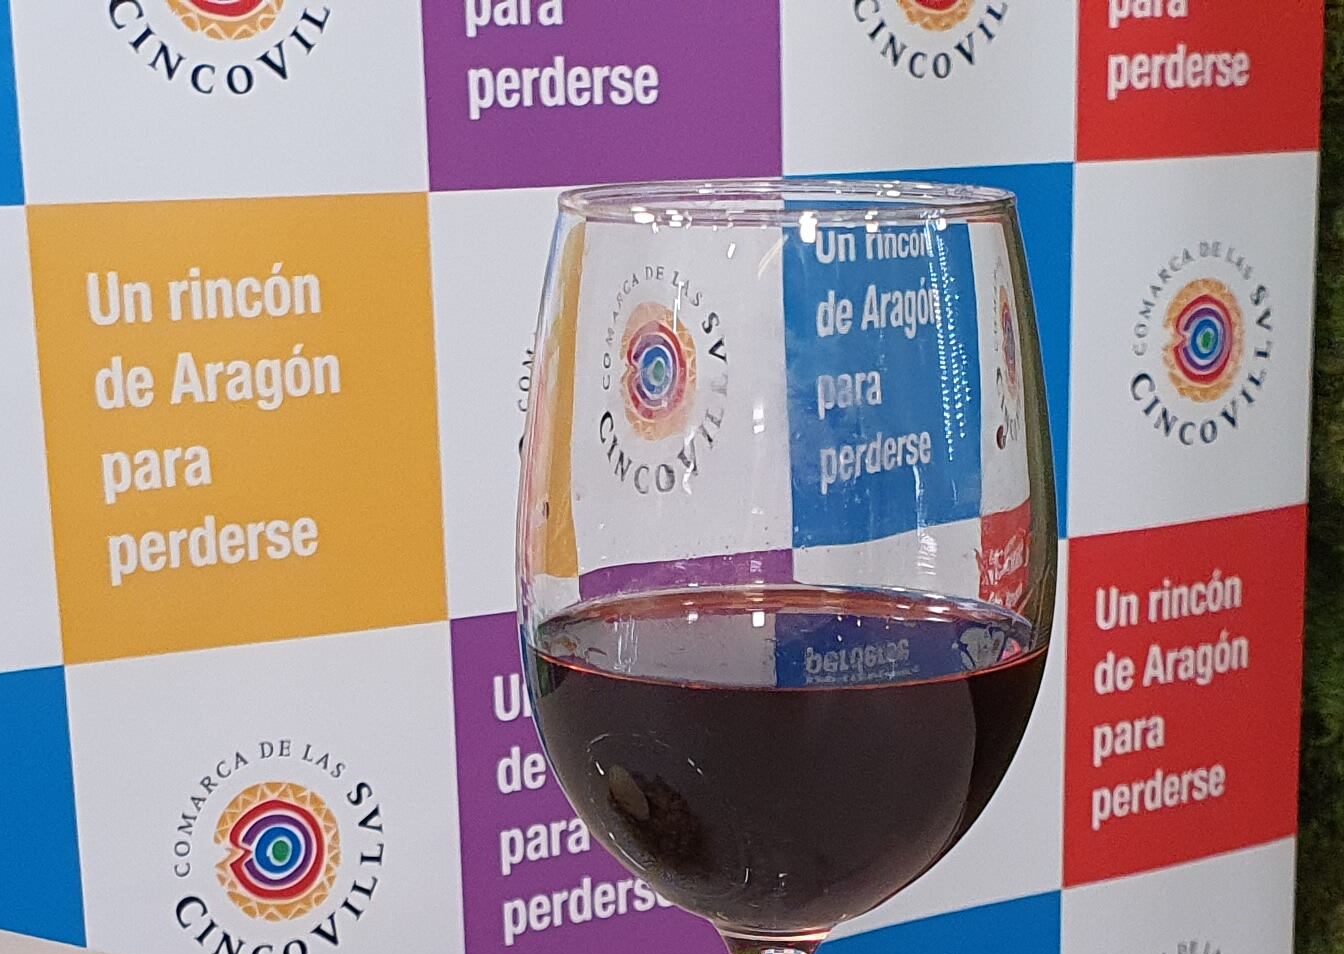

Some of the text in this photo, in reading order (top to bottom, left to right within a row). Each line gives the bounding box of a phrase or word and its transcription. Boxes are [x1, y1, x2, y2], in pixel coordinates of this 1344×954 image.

[109, 0, 331, 94] CINCOVIL
[853, 0, 1008, 78] CINCOVIL
[467, 55, 659, 120] perderse
[1107, 42, 1250, 100] perderse
[86, 262, 321, 325] Un rincón
[816, 290, 854, 337] de
[94, 344, 341, 411] de Aragón
[817, 370, 882, 420] para
[101, 444, 211, 503] para
[820, 431, 932, 494] perderse
[107, 515, 319, 586] perderse
[1096, 567, 1243, 631] Un rincón
[1093, 626, 1250, 695] de Aragón
[497, 747, 546, 794] de
[1093, 715, 1165, 768] para
[174, 740, 346, 877] COMARCA DE LAS
[1091, 763, 1227, 831] perderse
[500, 817, 590, 876] para
